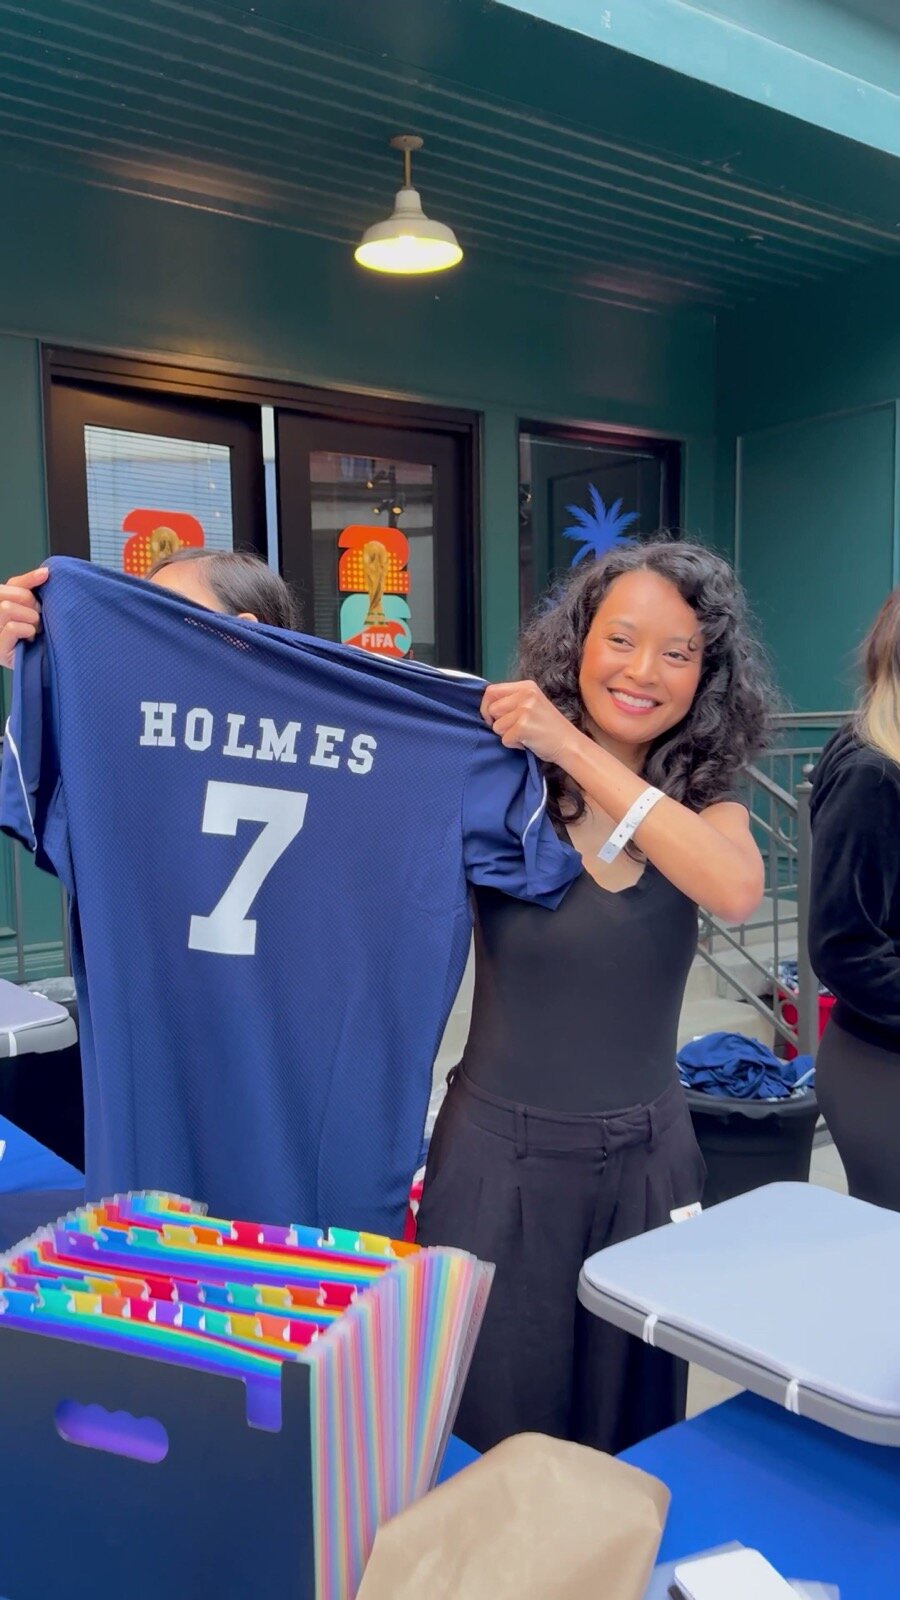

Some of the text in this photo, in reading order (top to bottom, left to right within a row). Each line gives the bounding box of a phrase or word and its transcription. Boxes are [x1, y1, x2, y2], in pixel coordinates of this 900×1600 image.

[361, 632, 394, 648] FIFA
[140, 702, 377, 774] HOLMES
[188, 781, 308, 955] 7
